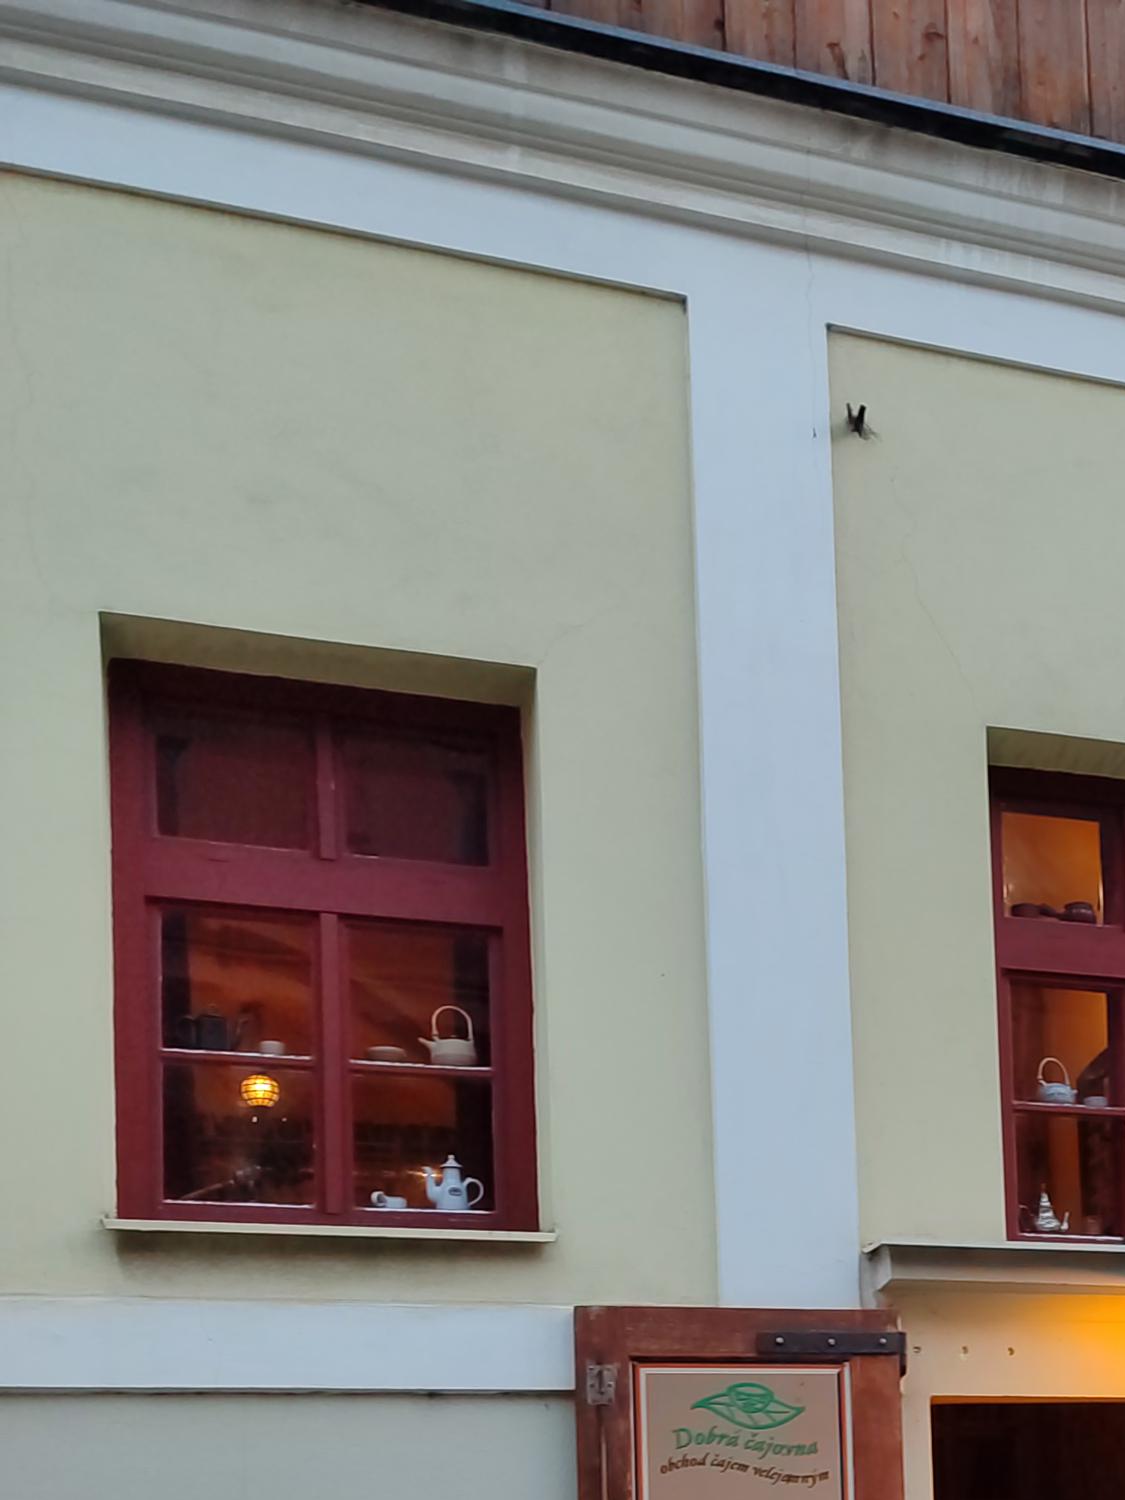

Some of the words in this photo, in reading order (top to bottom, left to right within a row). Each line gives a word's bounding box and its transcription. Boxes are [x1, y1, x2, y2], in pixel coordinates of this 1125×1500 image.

[672, 1426, 739, 1450] Dobrá
[744, 1433, 819, 1460] čajovna
[660, 1452, 707, 1475] obchod
[710, 1454, 750, 1473] čajem
